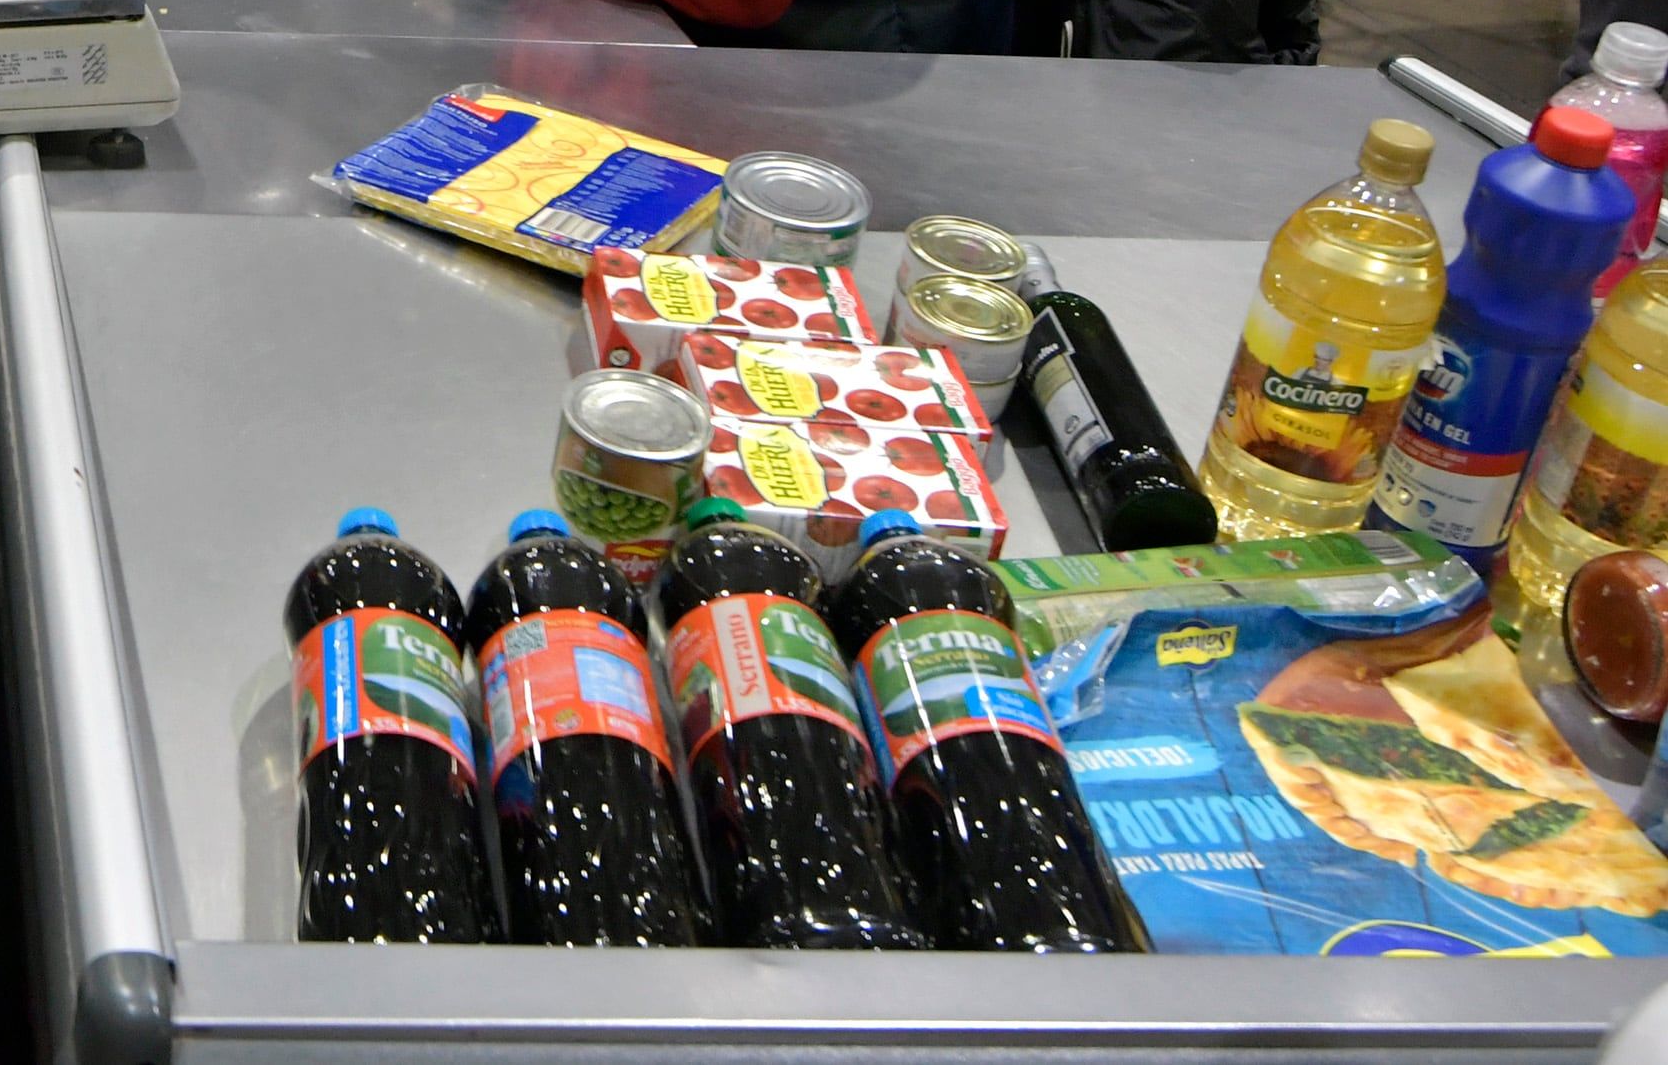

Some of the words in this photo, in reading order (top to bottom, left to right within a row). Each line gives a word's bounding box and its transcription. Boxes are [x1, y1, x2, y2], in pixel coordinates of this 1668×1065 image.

[1264, 376, 1363, 409] Cocinero
[1423, 411, 1443, 431] EN
[1443, 424, 1471, 445] GEL
[733, 613, 763, 699] Serrano
[874, 630, 1006, 672] Terma
[1163, 630, 1231, 656] Salteña
[1111, 855, 1161, 876] TART
[1157, 852, 1208, 872] PARA
[1206, 851, 1265, 870] TAPAS
